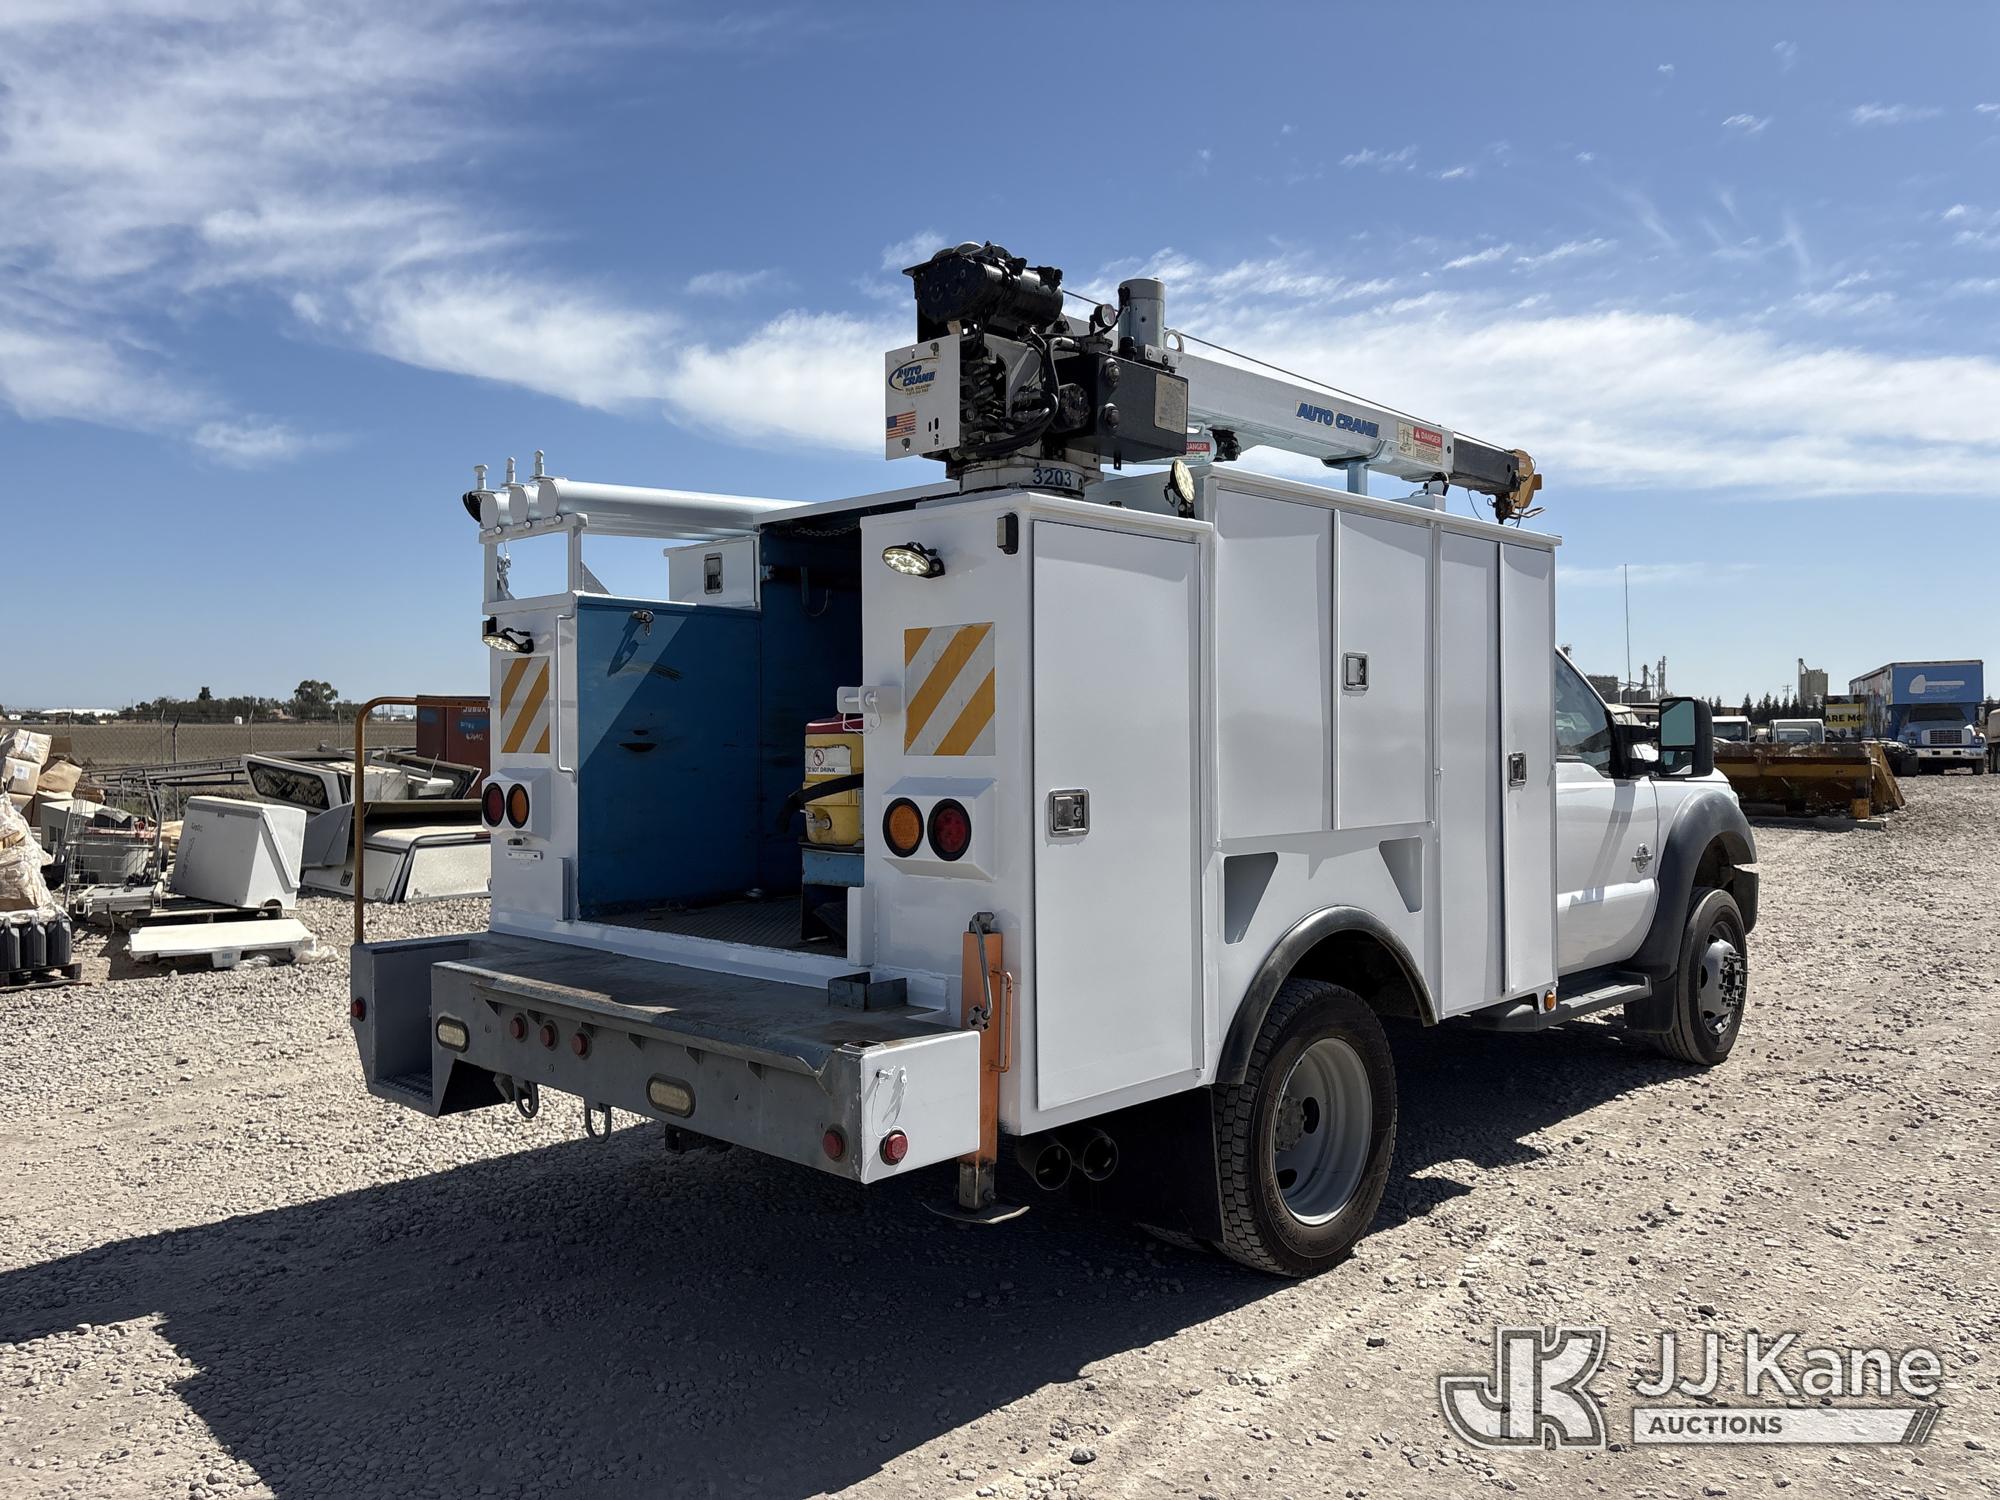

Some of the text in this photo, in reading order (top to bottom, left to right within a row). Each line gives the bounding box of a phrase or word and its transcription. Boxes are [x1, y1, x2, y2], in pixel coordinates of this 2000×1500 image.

[896, 365, 922, 379] AUTO
[903, 371, 936, 386] CRANE
[1296, 402, 1379, 438] AUTO CRANE
[1420, 431, 1441, 444] DANGER
[1032, 468, 1072, 487] 3203
